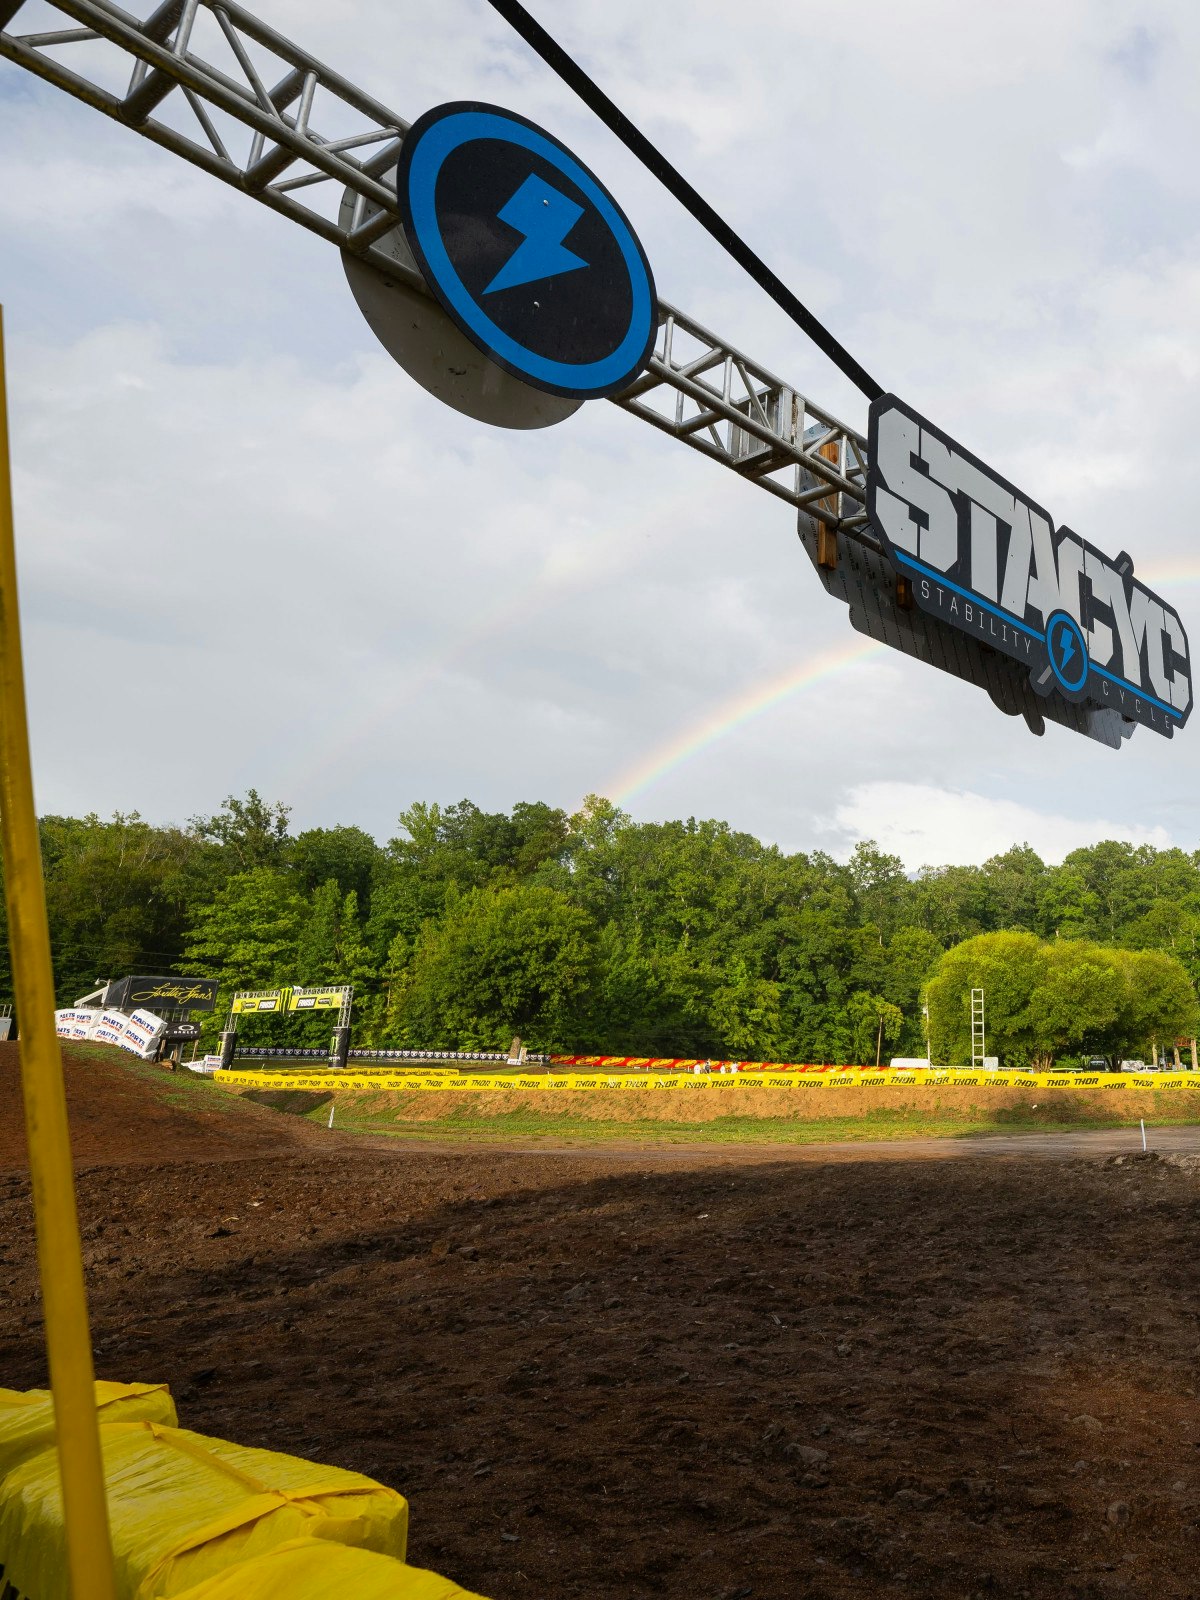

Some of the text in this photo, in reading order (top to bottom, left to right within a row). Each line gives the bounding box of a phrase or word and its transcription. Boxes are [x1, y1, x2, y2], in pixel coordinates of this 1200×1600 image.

[876, 407, 1190, 713] STACYC
[921, 580, 1170, 729] STABILITY CYCLE
[103, 1016, 123, 1030] PARTS
[132, 1014, 155, 1032] PARTS
[126, 1030, 146, 1046] PARTS
[518, 1080, 540, 1088] THOR
[574, 1080, 596, 1088] THOR
[654, 1080, 678, 1088] THOR
[712, 1080, 734, 1088] THOR
[738, 1078, 763, 1087] THOR
[798, 1080, 823, 1088] THOR
[829, 1078, 853, 1086] THOR
[860, 1078, 885, 1086] THOR
[890, 1076, 916, 1084] THOR
[924, 1076, 949, 1085] THOR
[953, 1078, 978, 1086] THOR
[984, 1078, 1008, 1086] THOR
[1014, 1079, 1038, 1088] THOR
[1074, 1078, 1098, 1086] THOR
[1132, 1080, 1154, 1088] THOR
[1160, 1080, 1182, 1088] THOR
